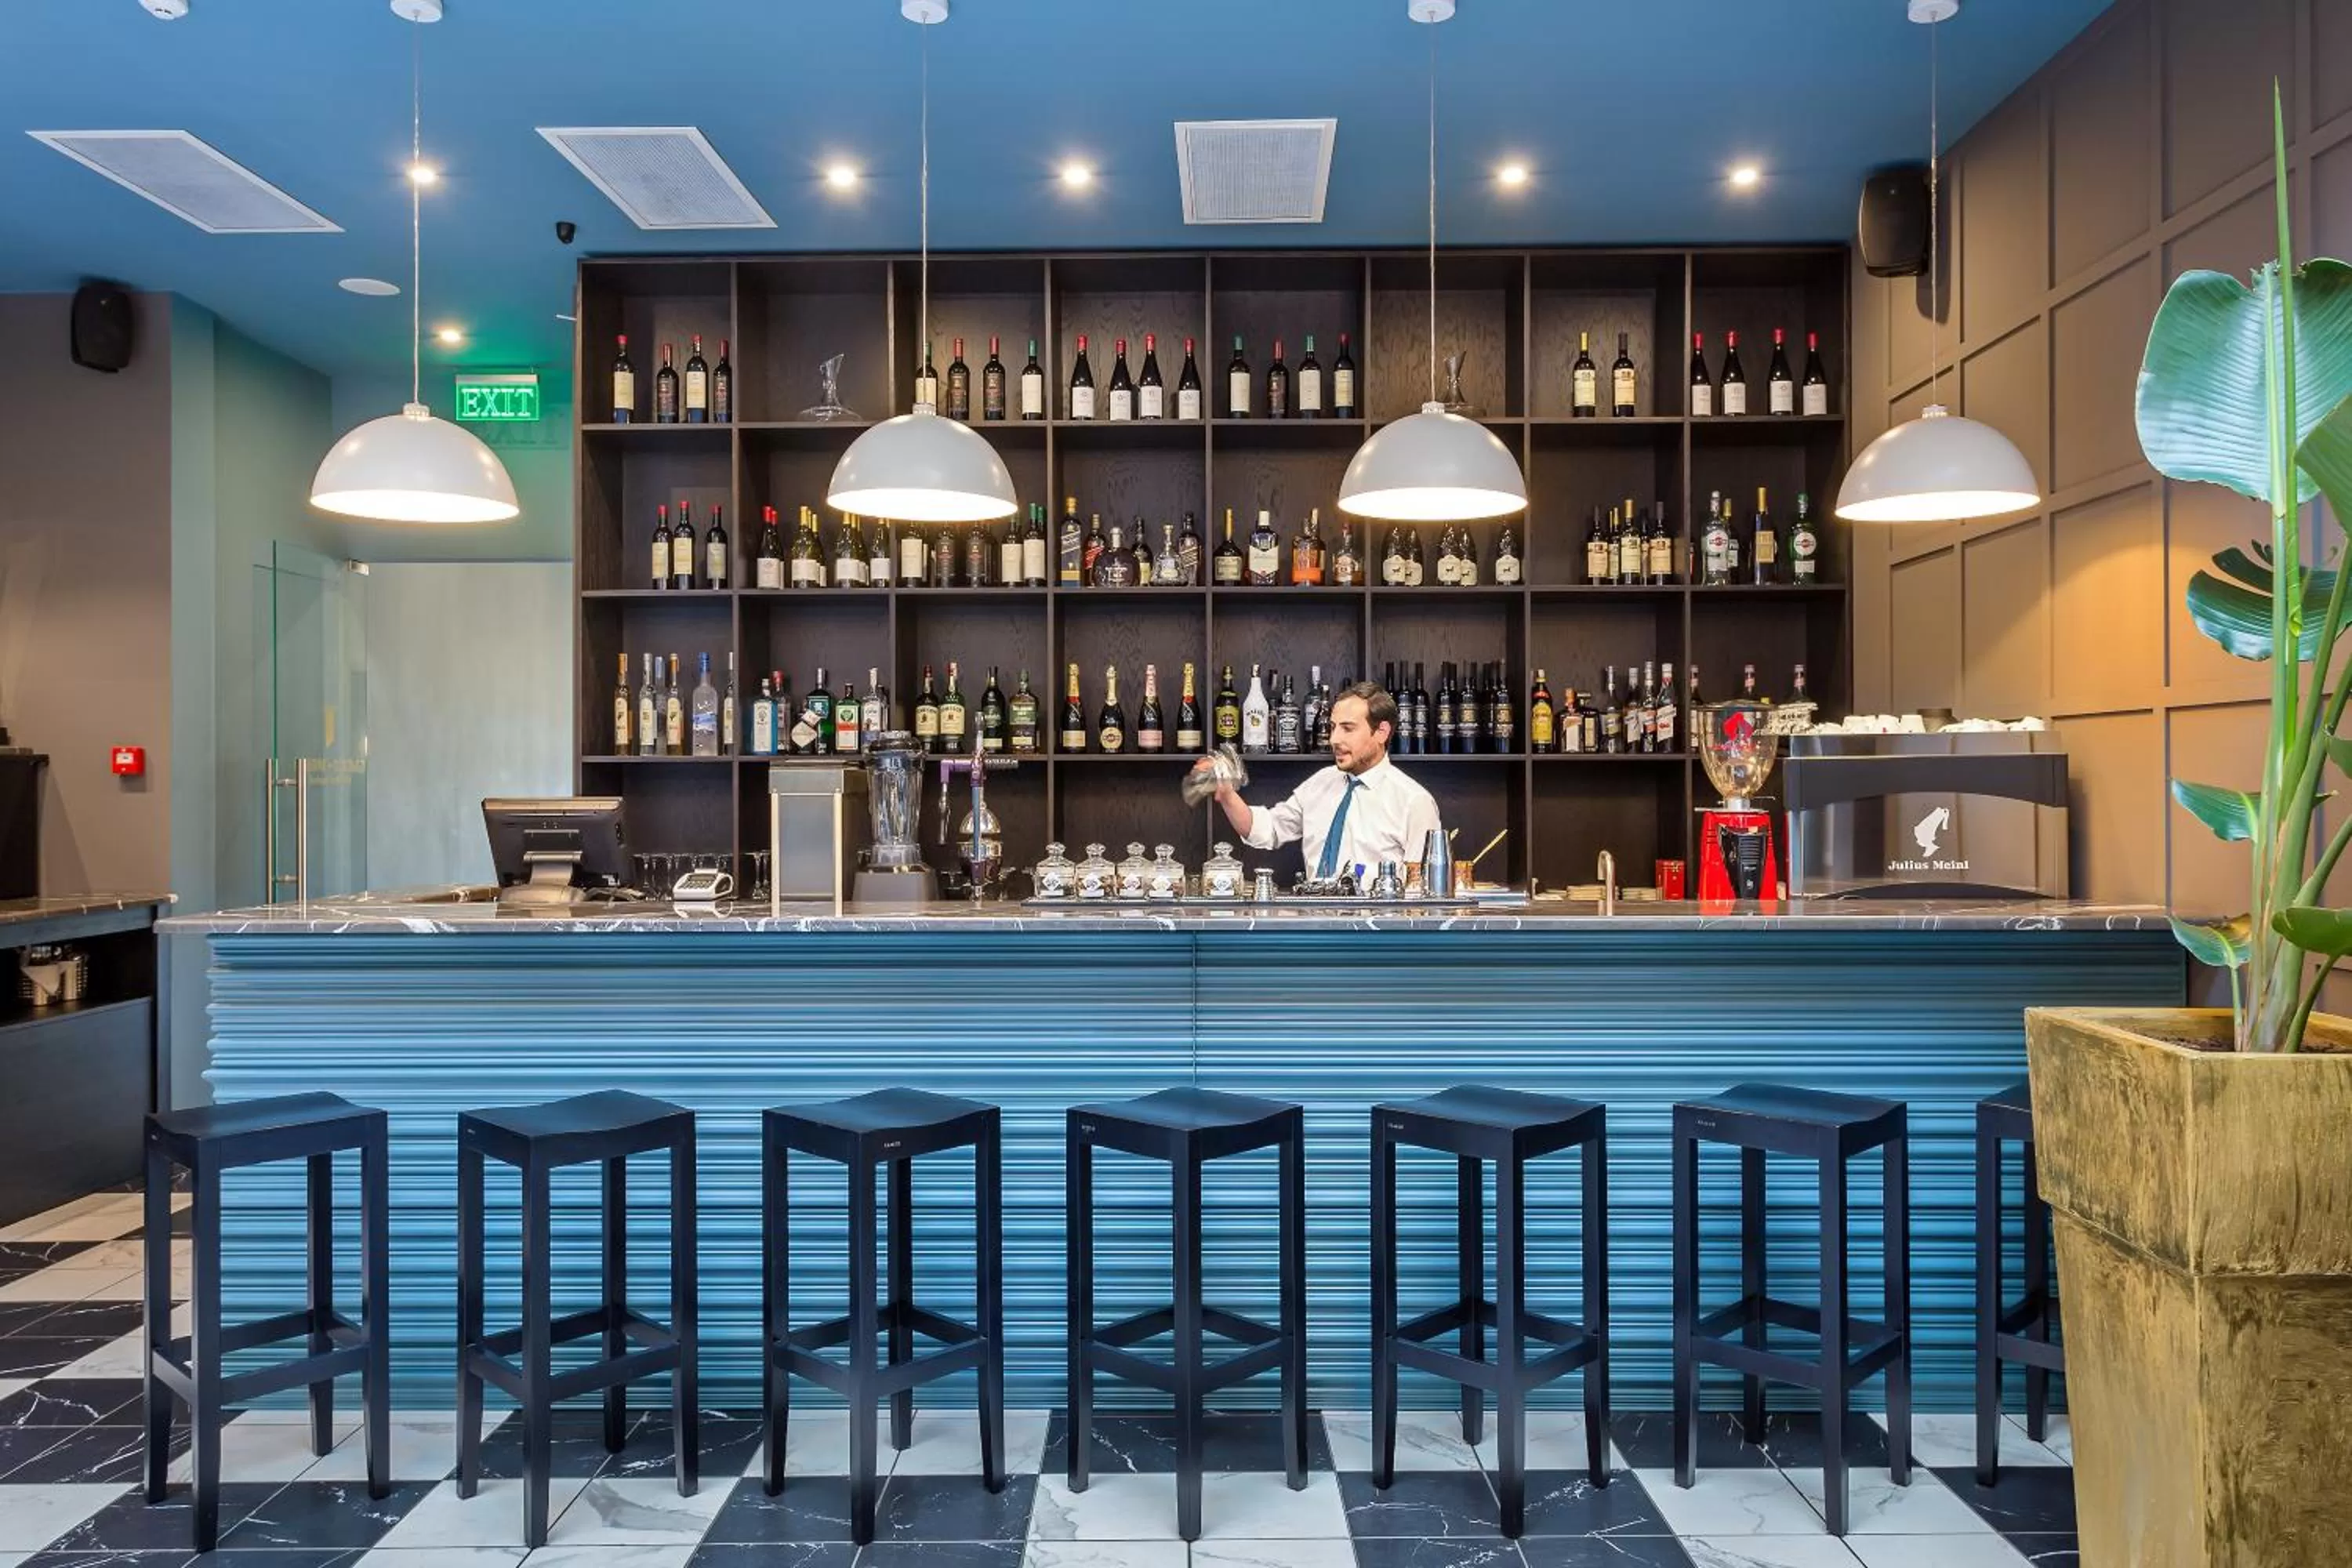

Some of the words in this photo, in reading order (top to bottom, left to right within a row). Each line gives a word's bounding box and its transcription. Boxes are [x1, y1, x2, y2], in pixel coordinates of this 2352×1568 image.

[461, 388, 533, 417] EXIT
[1888, 860, 1929, 870] Julius
[1933, 860, 1969, 869] Meinl
